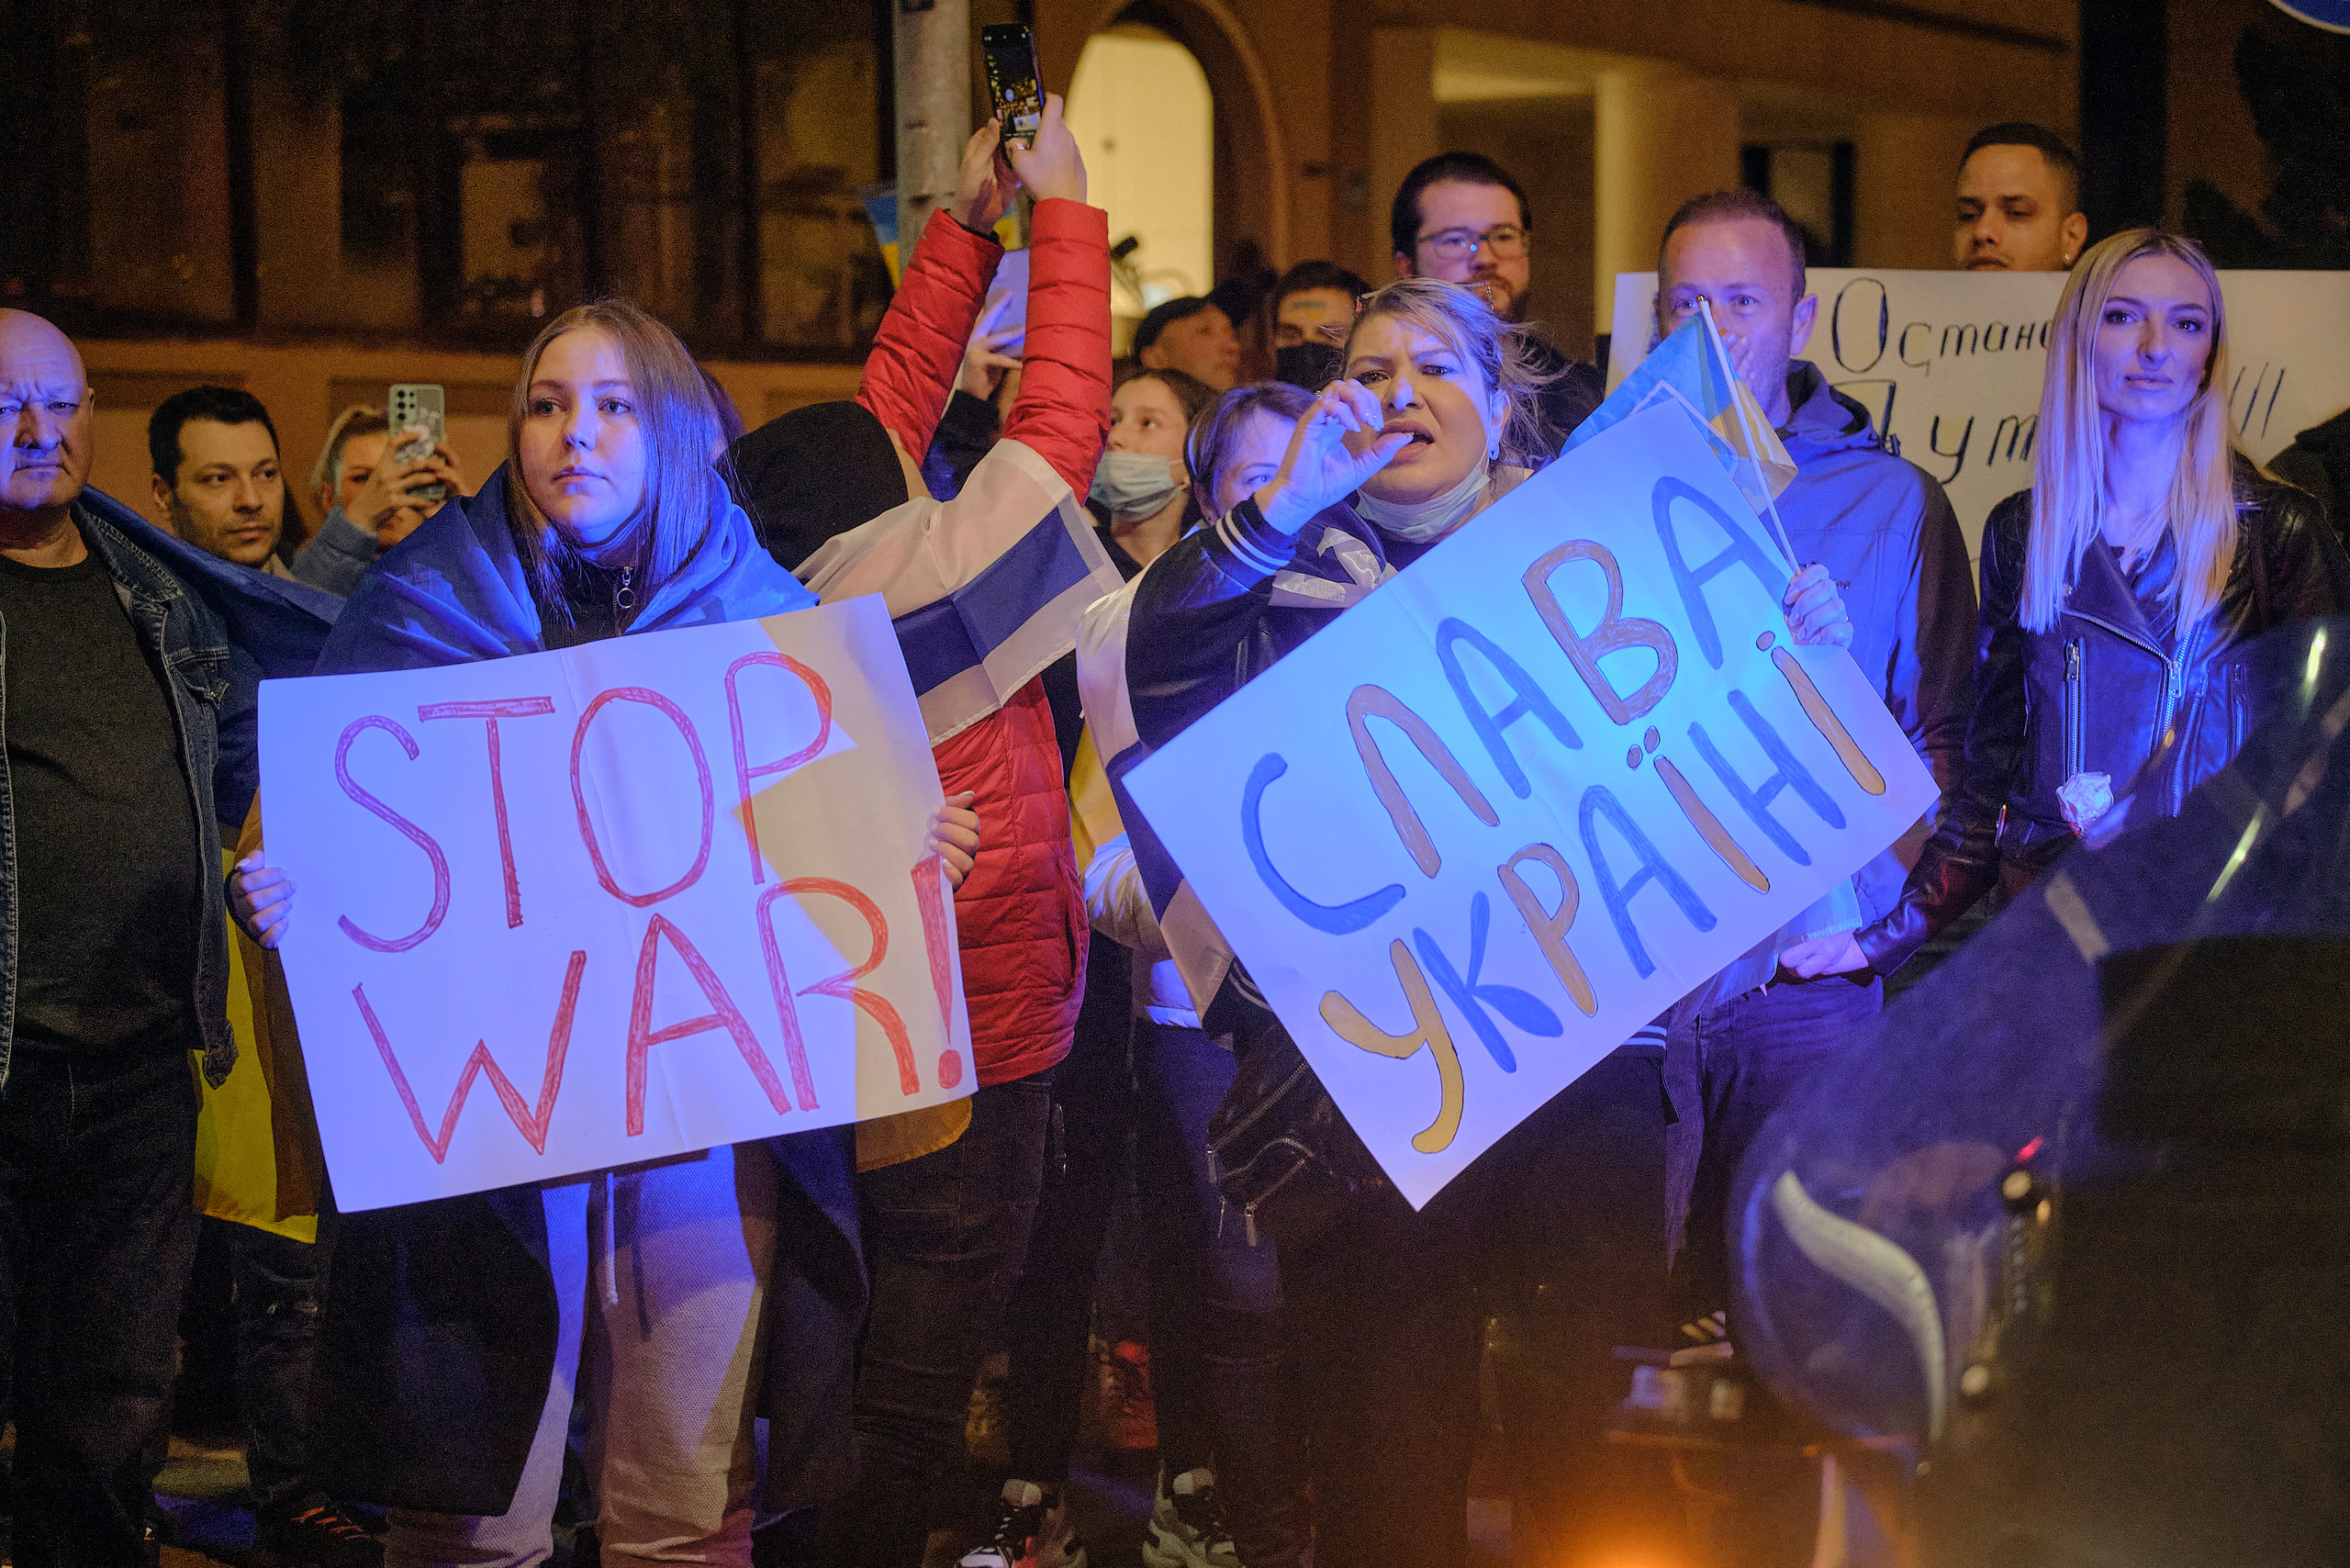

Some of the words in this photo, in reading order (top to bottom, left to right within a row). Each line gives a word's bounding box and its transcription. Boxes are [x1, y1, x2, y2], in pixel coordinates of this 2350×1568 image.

[335, 653, 833, 953] STOP
[1240, 476, 1788, 935] СЛАВА
[353, 856, 962, 1163] WAR!
